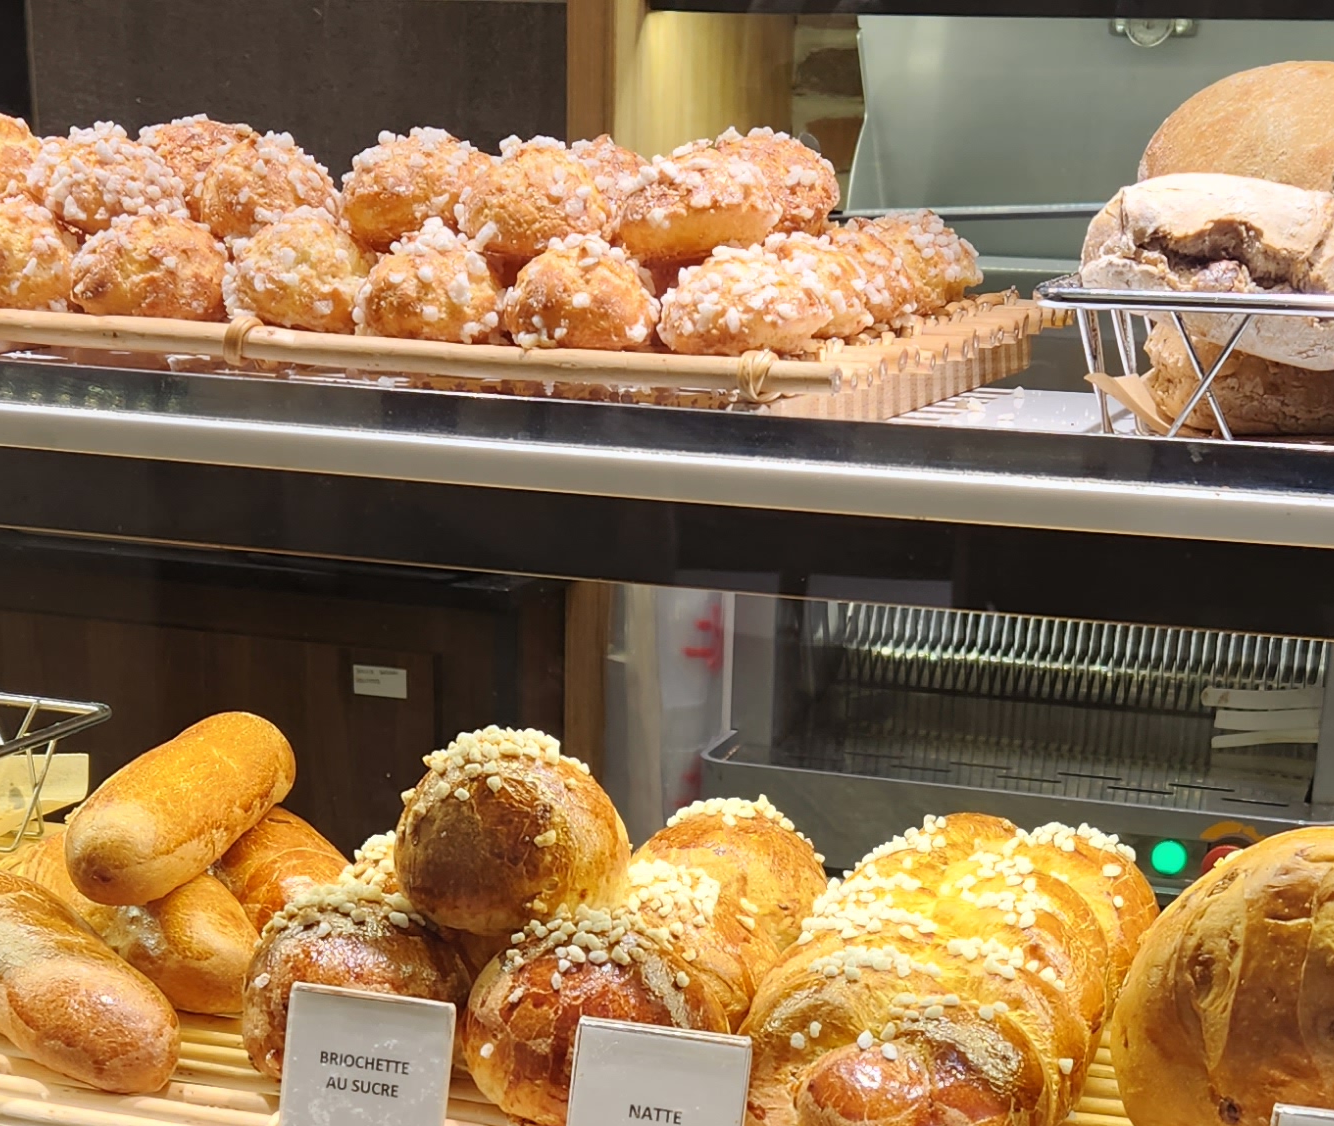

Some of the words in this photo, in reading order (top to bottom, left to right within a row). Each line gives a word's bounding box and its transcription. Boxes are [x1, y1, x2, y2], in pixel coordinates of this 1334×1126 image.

[320, 1050, 410, 1075] BRIOCHETTE
[326, 1076, 348, 1091] AU
[350, 1079, 399, 1098] SUCRE
[628, 1104, 682, 1125] NATTE
